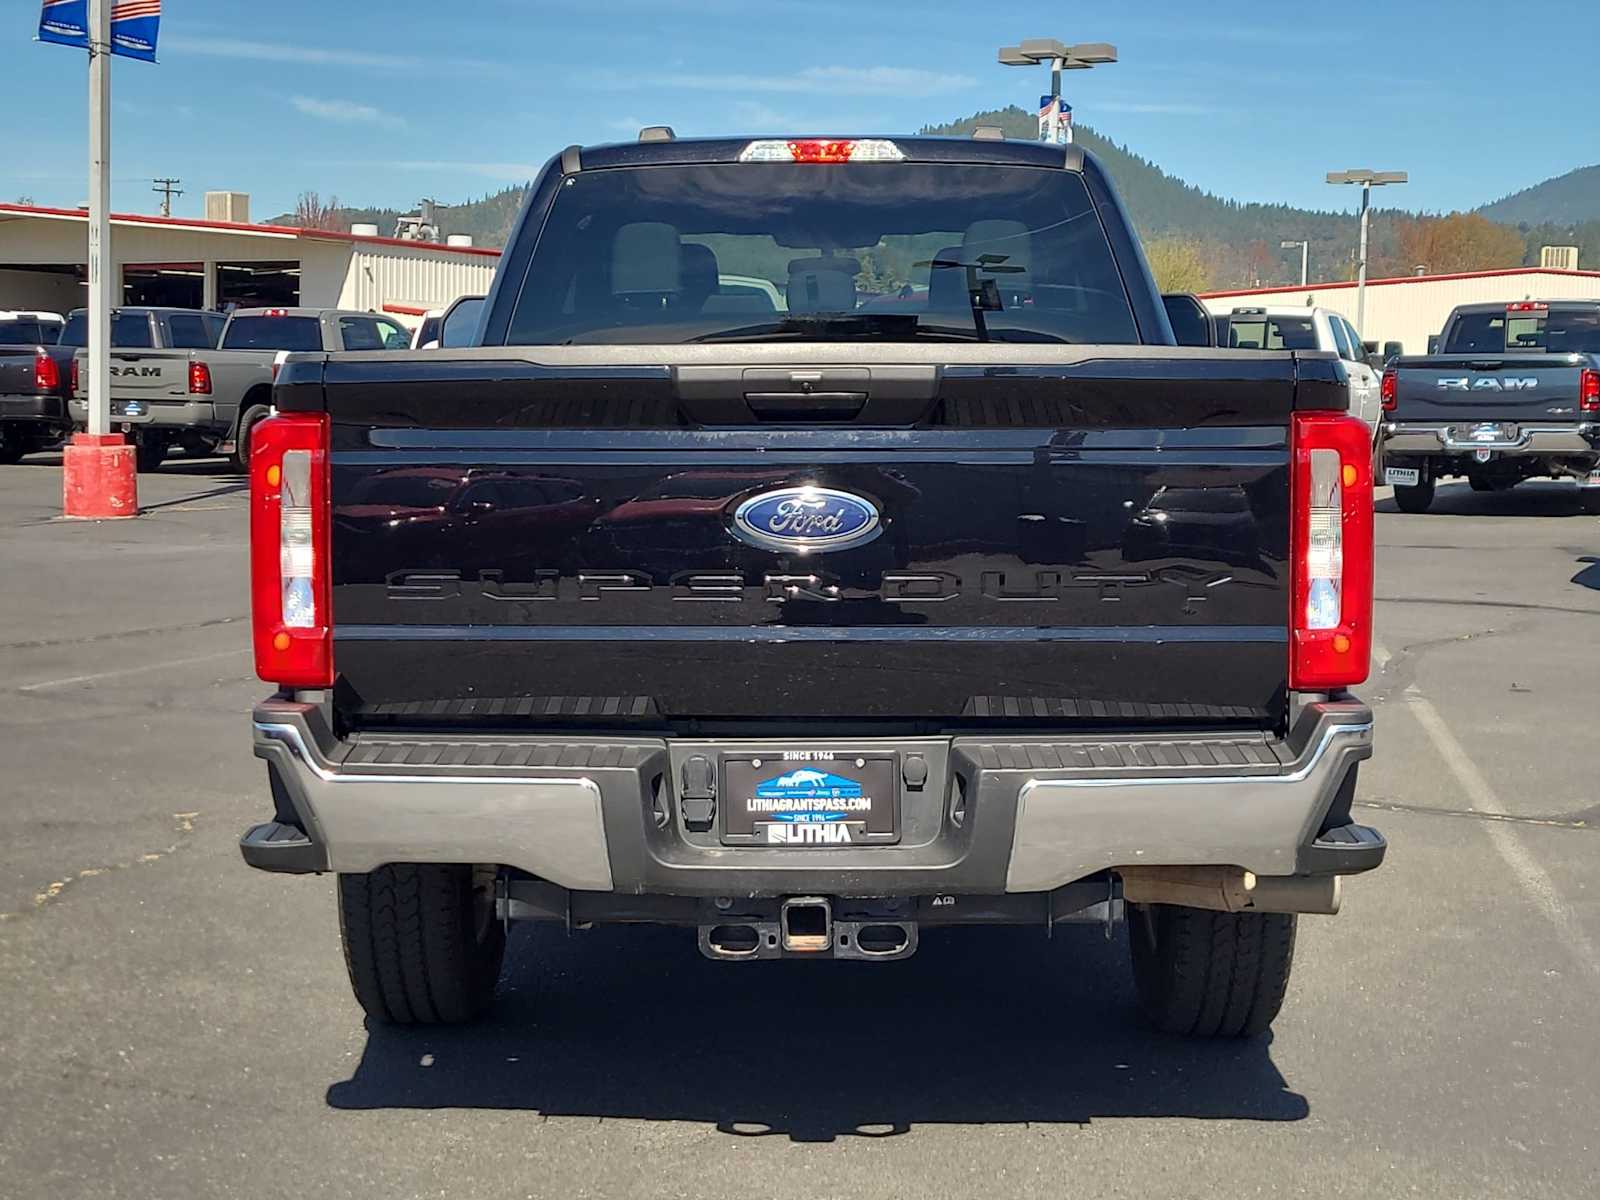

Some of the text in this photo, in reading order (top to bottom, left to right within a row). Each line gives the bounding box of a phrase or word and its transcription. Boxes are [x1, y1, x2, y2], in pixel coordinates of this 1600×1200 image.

[1438, 377, 1538, 391] RAM
[768, 499, 845, 532] Ford
[386, 569, 1234, 602] SUPER DUTY
[783, 752, 811, 760] SINCE
[747, 798, 871, 811] LITHIAGRANTSPASS.COM
[787, 824, 852, 843] LITHIA
